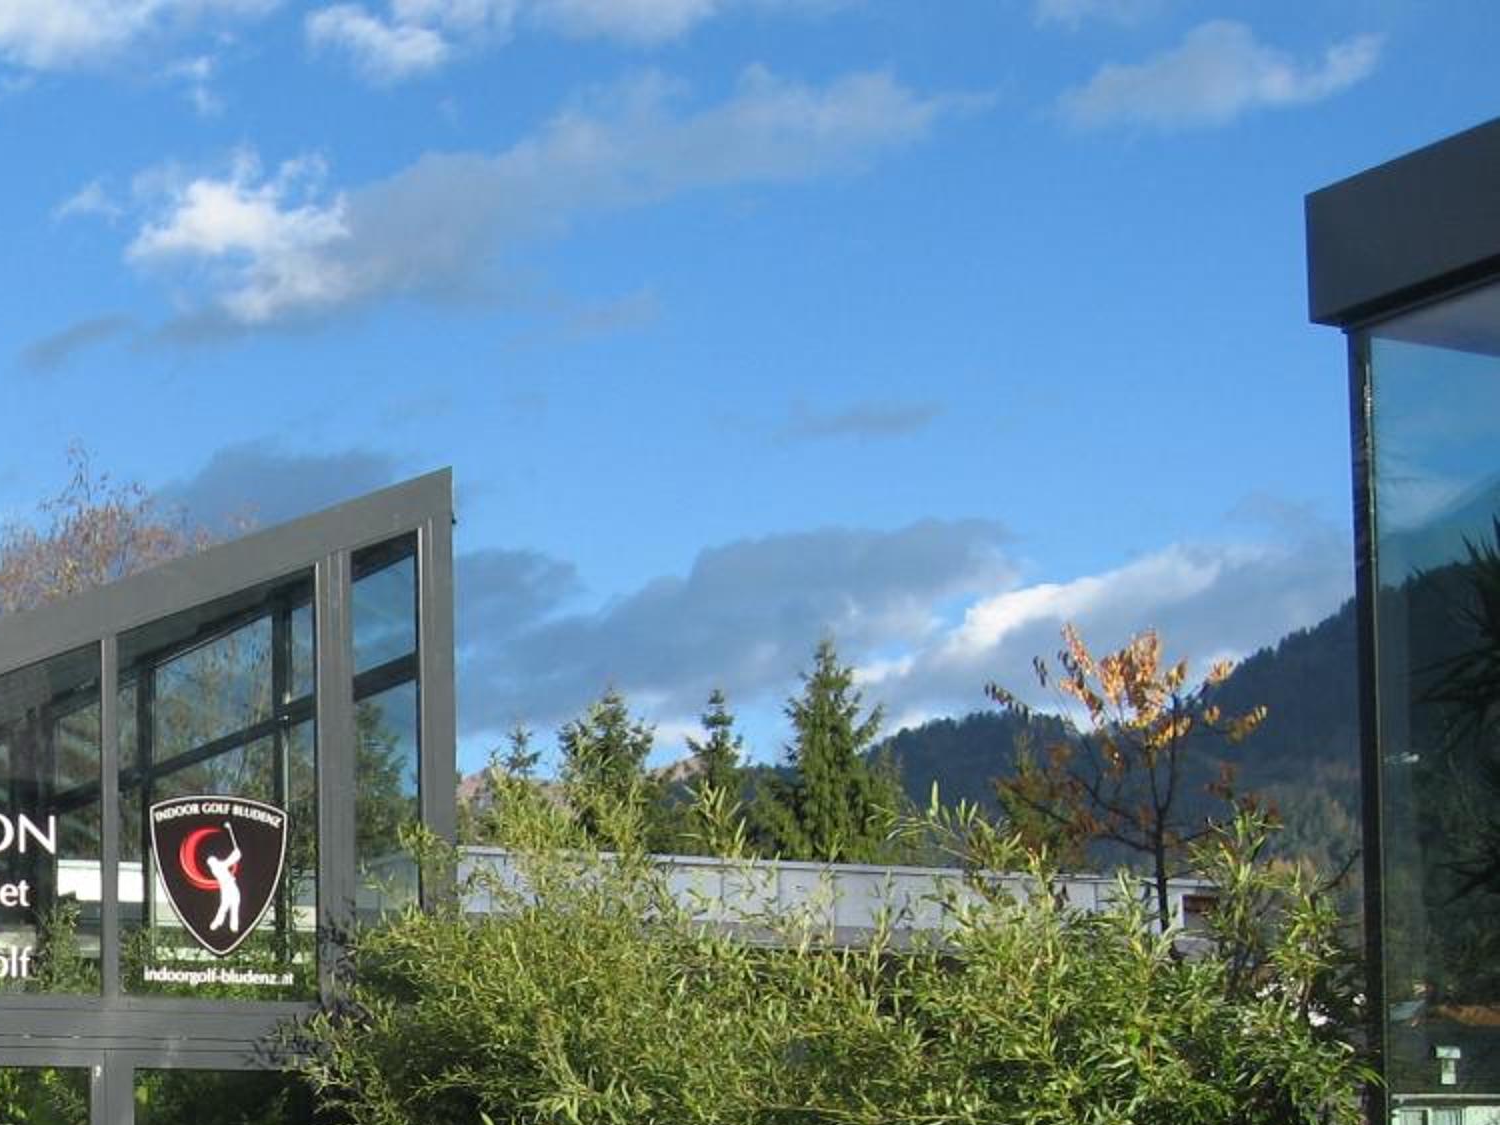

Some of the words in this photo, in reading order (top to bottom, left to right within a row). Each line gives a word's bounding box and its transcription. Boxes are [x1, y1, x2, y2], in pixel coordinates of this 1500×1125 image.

[155, 804, 200, 822] INDOOR
[201, 803, 230, 815] GOLF
[231, 806, 281, 829] BLUDENZ
